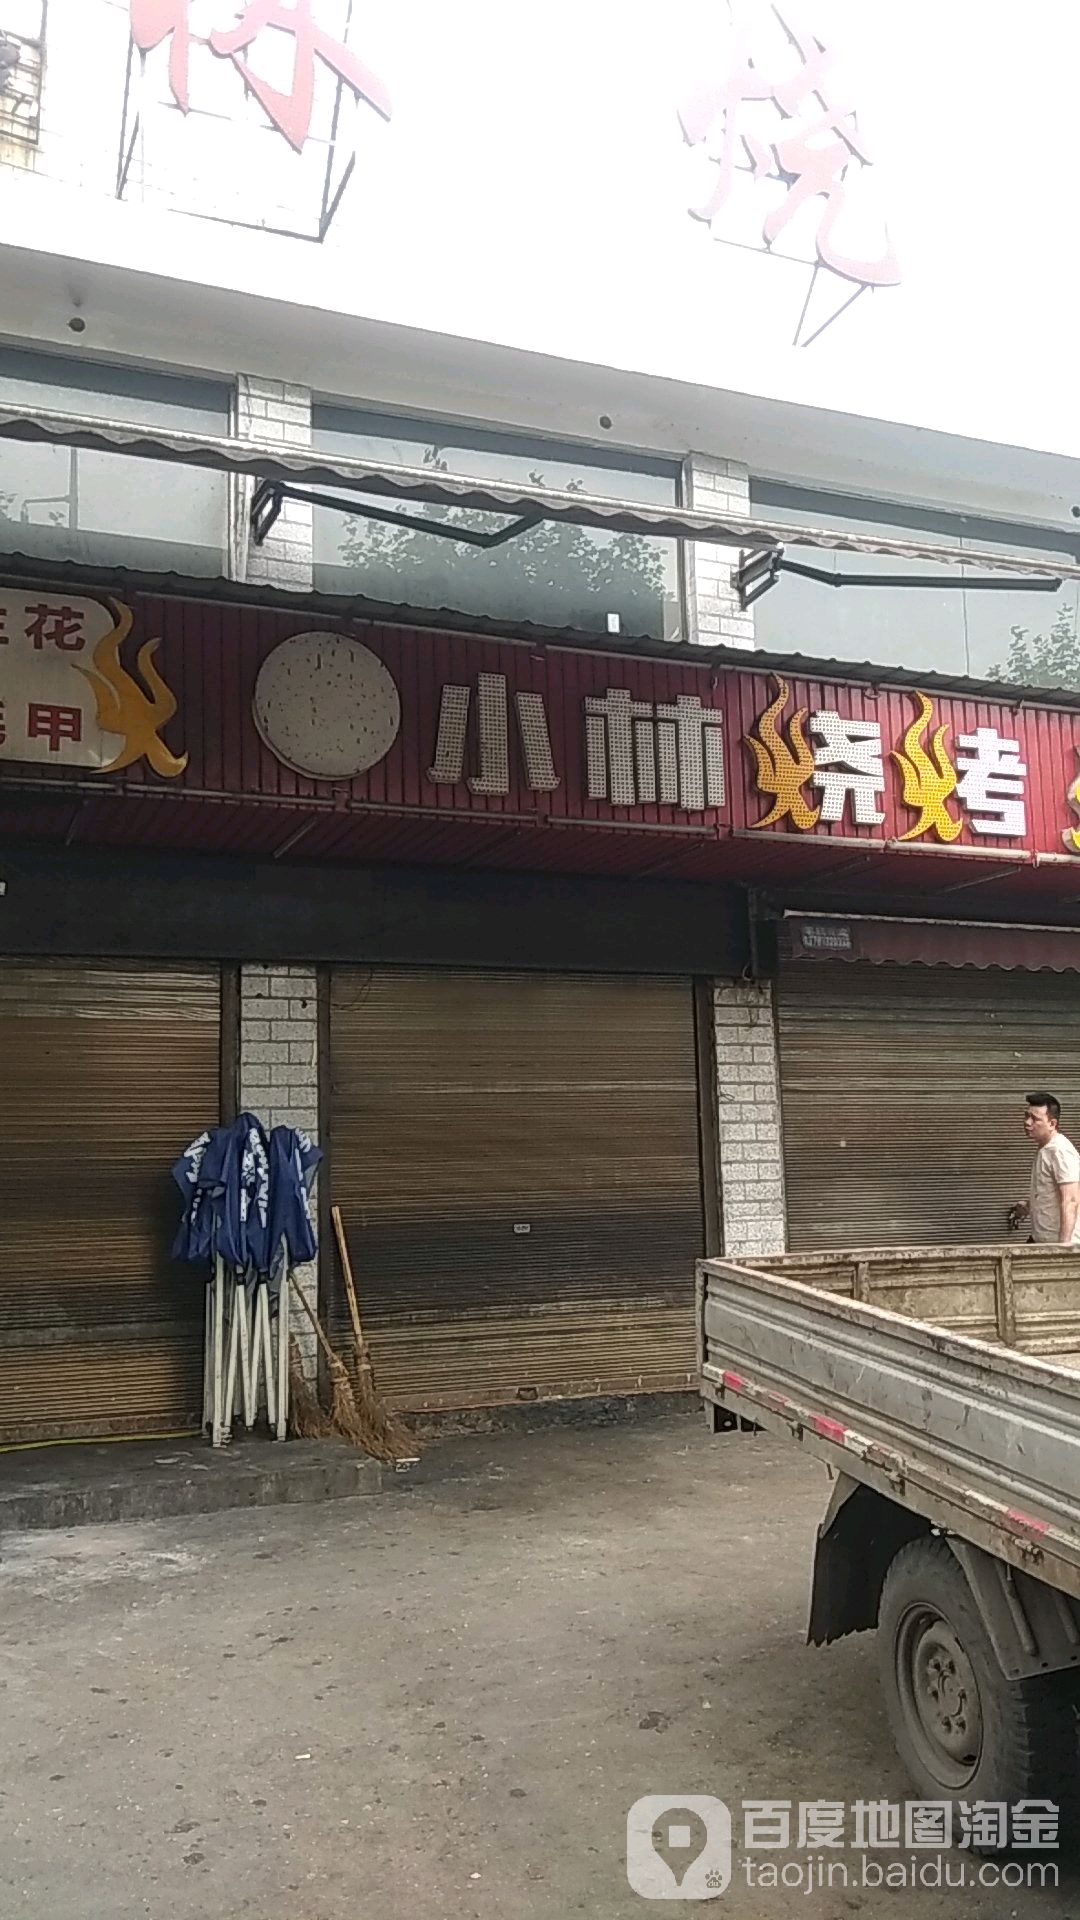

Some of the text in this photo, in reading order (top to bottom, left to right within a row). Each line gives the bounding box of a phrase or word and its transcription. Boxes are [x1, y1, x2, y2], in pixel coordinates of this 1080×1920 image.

[0, 603, 86, 652] 花
[0, 703, 83, 752] 甲
[426, 672, 1028, 841] 小林烧烤
